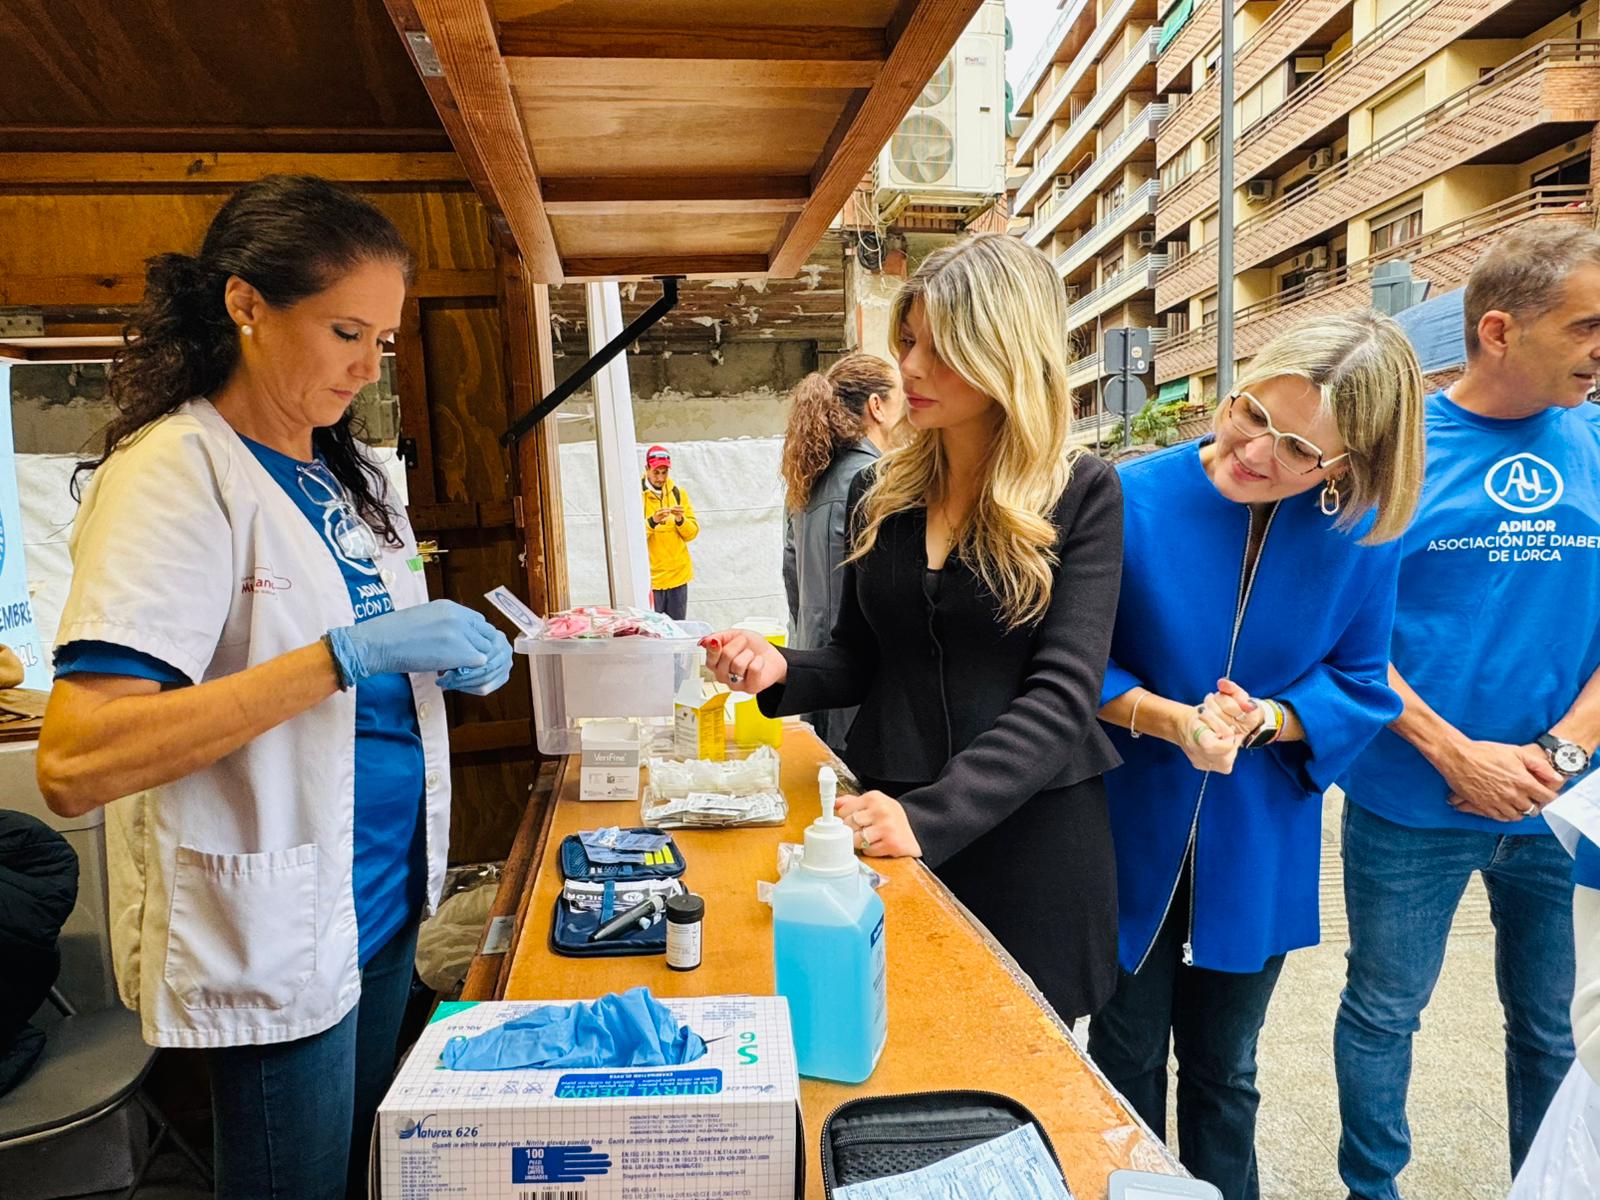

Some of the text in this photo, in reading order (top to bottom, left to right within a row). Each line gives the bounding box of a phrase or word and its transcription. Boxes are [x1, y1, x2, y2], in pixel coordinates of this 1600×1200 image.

[1498, 520, 1556, 533] ADILOR
[1427, 534, 1523, 551] ASOCIACIÓN
[1526, 535, 1546, 547] DE
[1488, 550, 1562, 562] DE LORCA
[739, 1032, 755, 1044] 6
[737, 1045, 758, 1065] S
[560, 1083, 717, 1098] NITRYL DERM
[400, 1117, 478, 1139] Naturex 626
[525, 1149, 544, 1159] 100
